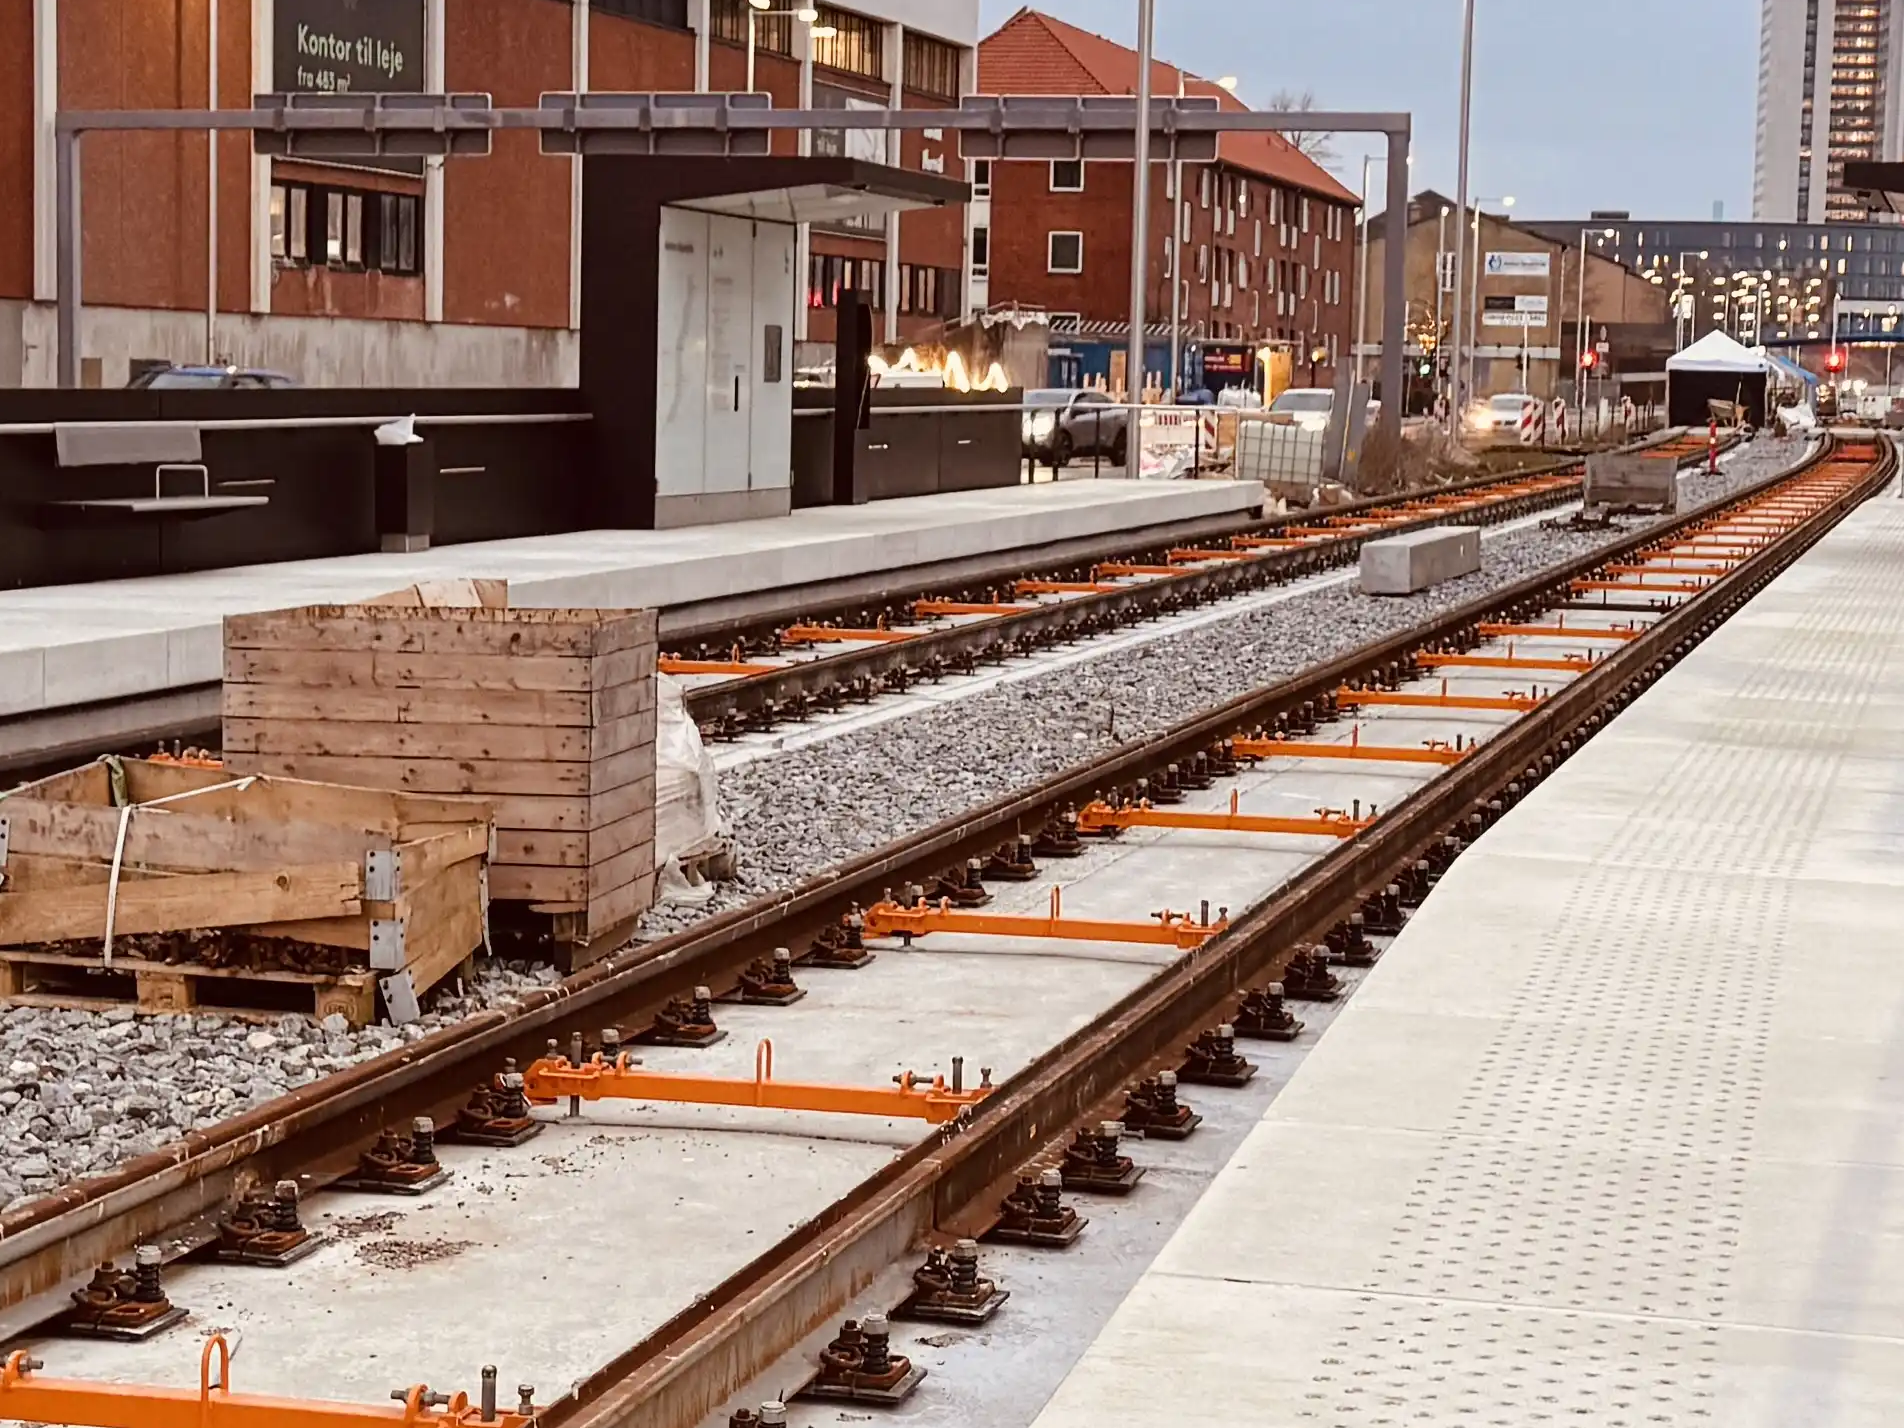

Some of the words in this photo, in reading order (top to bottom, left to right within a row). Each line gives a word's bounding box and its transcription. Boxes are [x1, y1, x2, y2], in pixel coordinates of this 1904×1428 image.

[298, 23, 352, 62] Kontor
[356, 36, 373, 67] til
[377, 40, 404, 79] leje
[297, 65, 314, 88] fra
